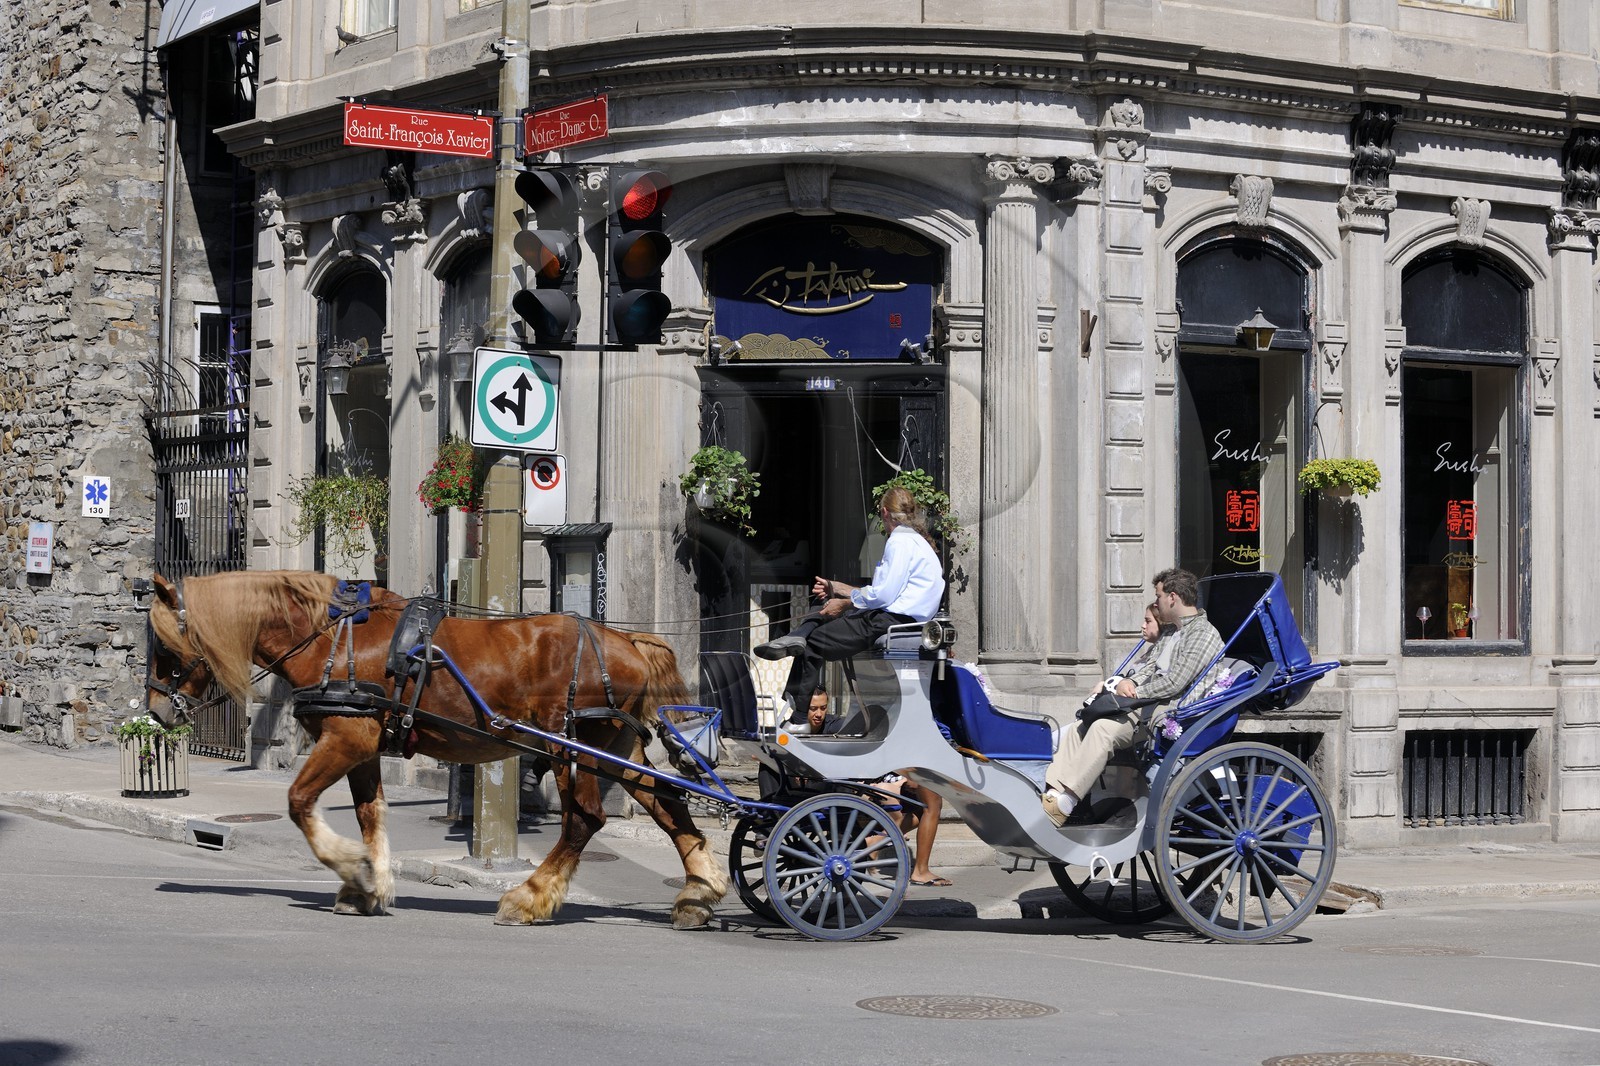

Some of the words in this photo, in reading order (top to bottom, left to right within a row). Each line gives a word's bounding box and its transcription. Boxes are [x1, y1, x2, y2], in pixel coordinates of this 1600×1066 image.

[411, 115, 429, 126] Rue
[531, 121, 586, 146] Notre-Dame
[589, 113, 601, 132] O.
[560, 111, 570, 121] Rue
[348, 119, 443, 148] Saint-François
[446, 129, 489, 149] Xavier
[810, 375, 830, 389] 140
[1211, 428, 1273, 464] Sushi
[1433, 441, 1490, 475] Sushi
[176, 502, 188, 515] 130
[596, 552, 607, 615] CASTRO
